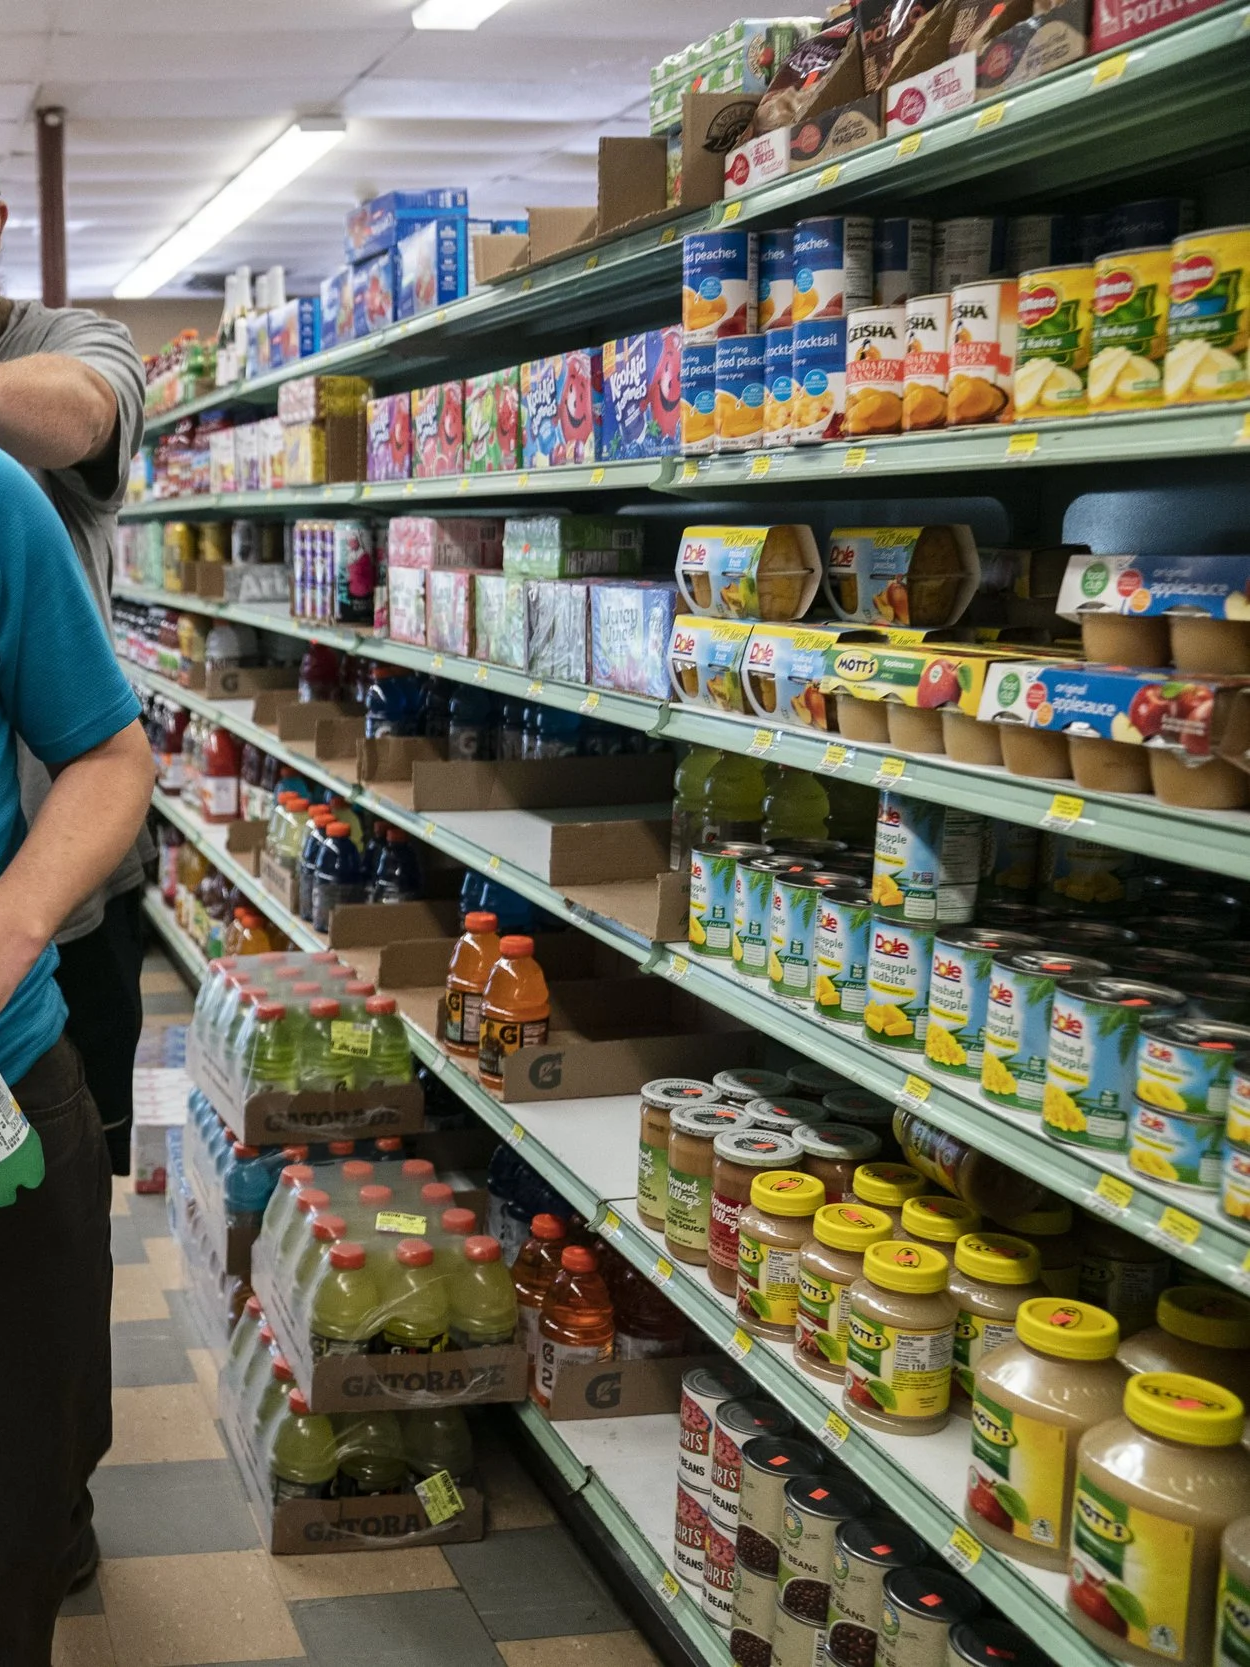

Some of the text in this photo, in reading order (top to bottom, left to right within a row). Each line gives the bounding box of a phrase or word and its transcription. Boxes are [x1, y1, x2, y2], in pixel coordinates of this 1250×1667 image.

[1122, 0, 1196, 30] POTA
[610, 344, 646, 402] Kool-Aid
[683, 544, 707, 561] Dole
[830, 546, 854, 564] Dole
[1151, 581, 1228, 596] applesauce
[605, 605, 638, 630] Juicy
[606, 626, 635, 643] Juice
[674, 633, 695, 652] Dole
[750, 643, 773, 662] Dole
[837, 657, 875, 673] MOTT'S
[1052, 696, 1117, 717] applesauce
[875, 932, 910, 956] Dole
[873, 969, 907, 987] tidbits
[989, 979, 1014, 1004] ole
[499, 1025, 519, 1045] G
[529, 1053, 565, 1091] G
[679, 1220, 706, 1234] Sauce
[800, 1279, 828, 1301] OTT'S
[911, 1364, 927, 1372] 110
[585, 1371, 624, 1410] G
[681, 1458, 706, 1477] BEANS
[712, 1493, 739, 1515] BEANS
[678, 1552, 704, 1572] BEANS
[788, 1553, 819, 1574] BEANS
[836, 1599, 867, 1623] BEANS
